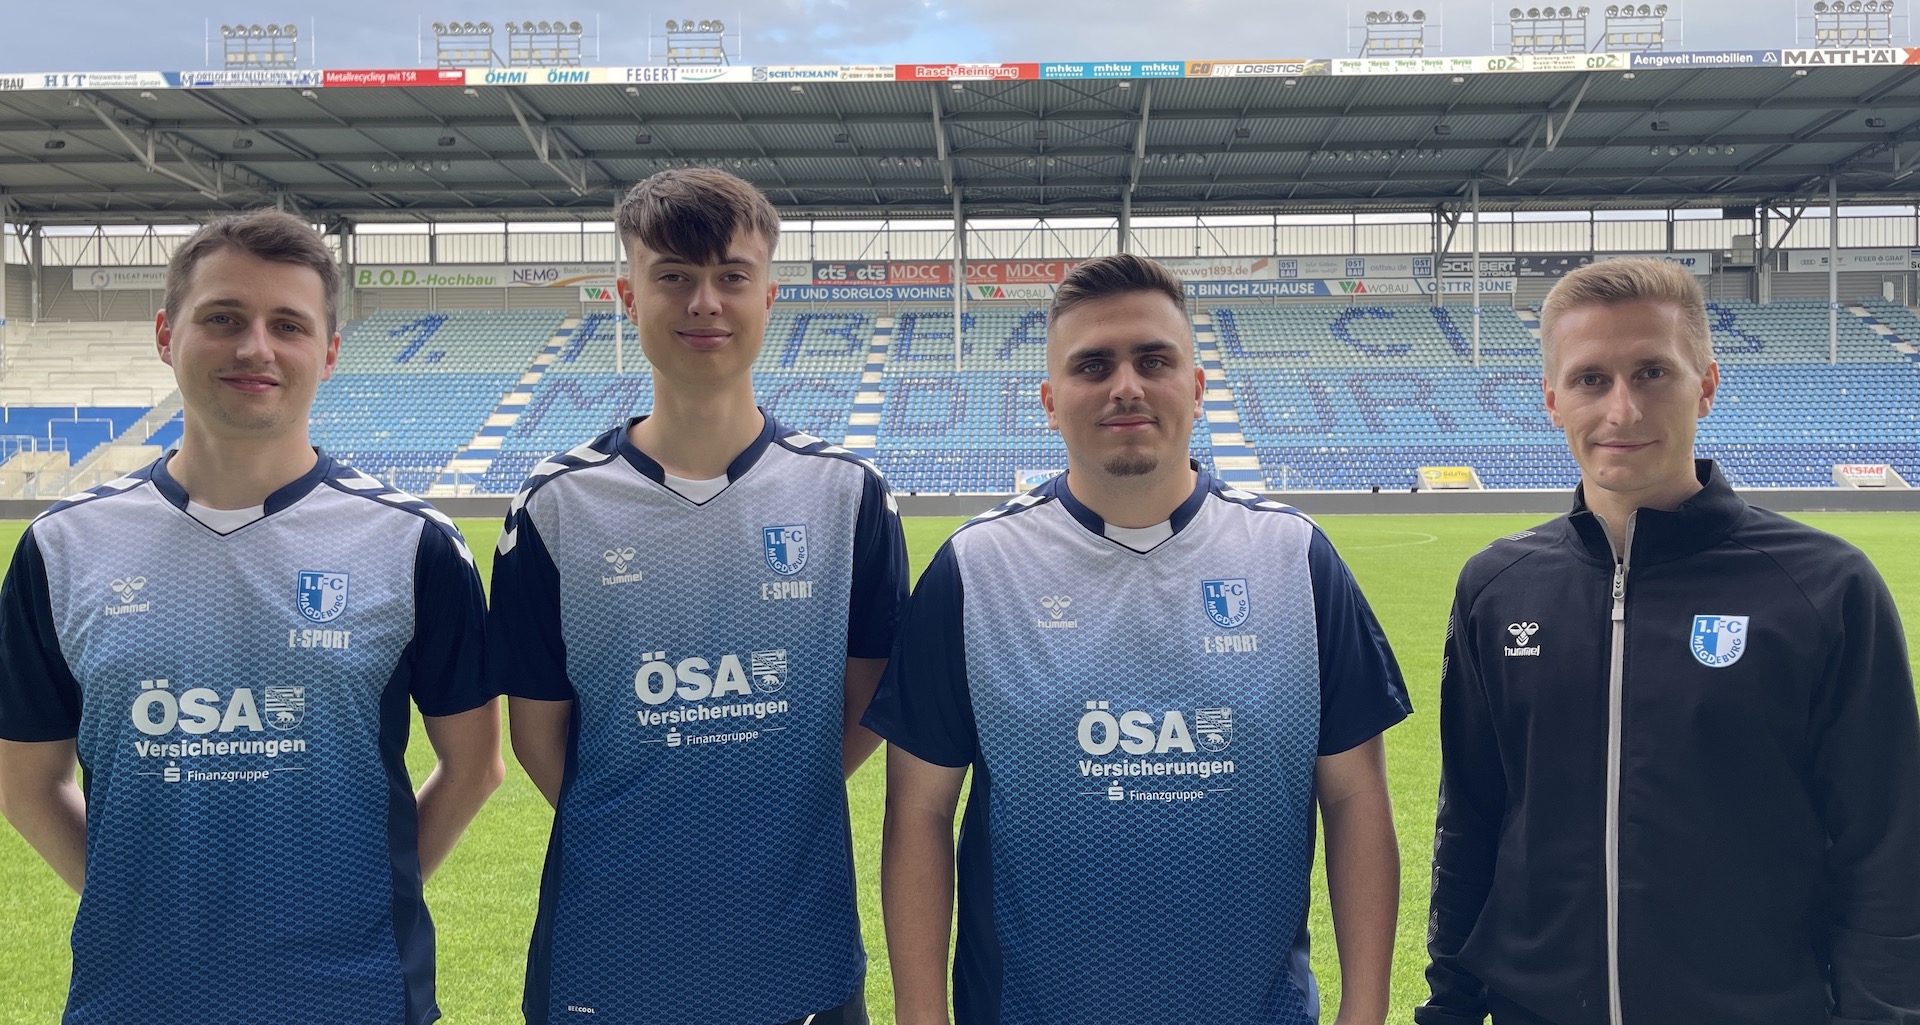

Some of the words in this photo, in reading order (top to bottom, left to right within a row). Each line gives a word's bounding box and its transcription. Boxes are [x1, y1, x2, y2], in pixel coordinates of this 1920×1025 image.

[1634, 54, 1690, 66] Aengevelt
[1692, 53, 1753, 64] Immobilien
[1784, 50, 1896, 65] MATTHÄI
[769, 67, 838, 79] SCHÜNEMANN
[915, 66, 1019, 79] Rasch-Reinigung
[1046, 64, 1083, 73] mhkw
[1094, 63, 1131, 72] mhkw
[1142, 63, 1179, 72] mhkw
[1236, 64, 1304, 74] LOGISTICS
[326, 71, 386, 84] Metallrecycling
[387, 72, 400, 82] mit
[402, 72, 417, 82] TSR
[485, 70, 528, 84] ÖHMI
[547, 70, 590, 84] ÖHMI
[627, 68, 678, 82] FEGERT
[143, 271, 166, 279] MULTI
[512, 267, 558, 281] NEMO
[818, 264, 847, 281] ets
[857, 264, 886, 281] ets
[890, 265, 940, 279] MDCC
[1006, 263, 1056, 277] MDCC
[1168, 261, 1248, 278] ww.wg1893.de
[1414, 267, 1431, 275] BAU
[801, 287, 829, 299] UND
[832, 287, 893, 299] SORGLOS
[896, 286, 955, 299] WOHNEN
[1006, 289, 1046, 298] WOBAU
[1199, 284, 1221, 295] BIN
[1225, 283, 1249, 295] ICH
[1252, 282, 1315, 294] ZUHAUSE
[1368, 283, 1409, 293] WOBAU
[1428, 280, 1512, 293] OSTTRBÜNE
[767, 530, 804, 545] 1.FC
[768, 546, 805, 573] MAGDEBURG
[302, 576, 344, 591] 1.FC
[601, 570, 643, 586] hummel
[761, 580, 813, 600] E-SPORT
[1206, 583, 1244, 598] 1.FC
[105, 601, 150, 616] hummel
[300, 592, 344, 620] MAGDEBURG
[1207, 600, 1246, 625] MAGDEBURG
[1037, 618, 1078, 629] hummel
[1698, 619, 1742, 634] 1.FC
[289, 629, 351, 649] E-SPORT
[1204, 634, 1258, 653] E-SPORT
[1504, 645, 1541, 657] hummel
[1695, 635, 1741, 665] MAGDEBURG
[634, 650, 752, 705] ÖSA
[131, 679, 264, 736] ÖSA
[637, 700, 788, 726] Versicherungen
[1077, 700, 1197, 756] ÖSA
[687, 731, 759, 745] Finanzgruppe
[134, 738, 306, 758] Versicherungen
[187, 769, 269, 782] Finanzgruppe
[1079, 759, 1234, 778] Versicherungen
[1130, 790, 1204, 802] Finanzgruppe
